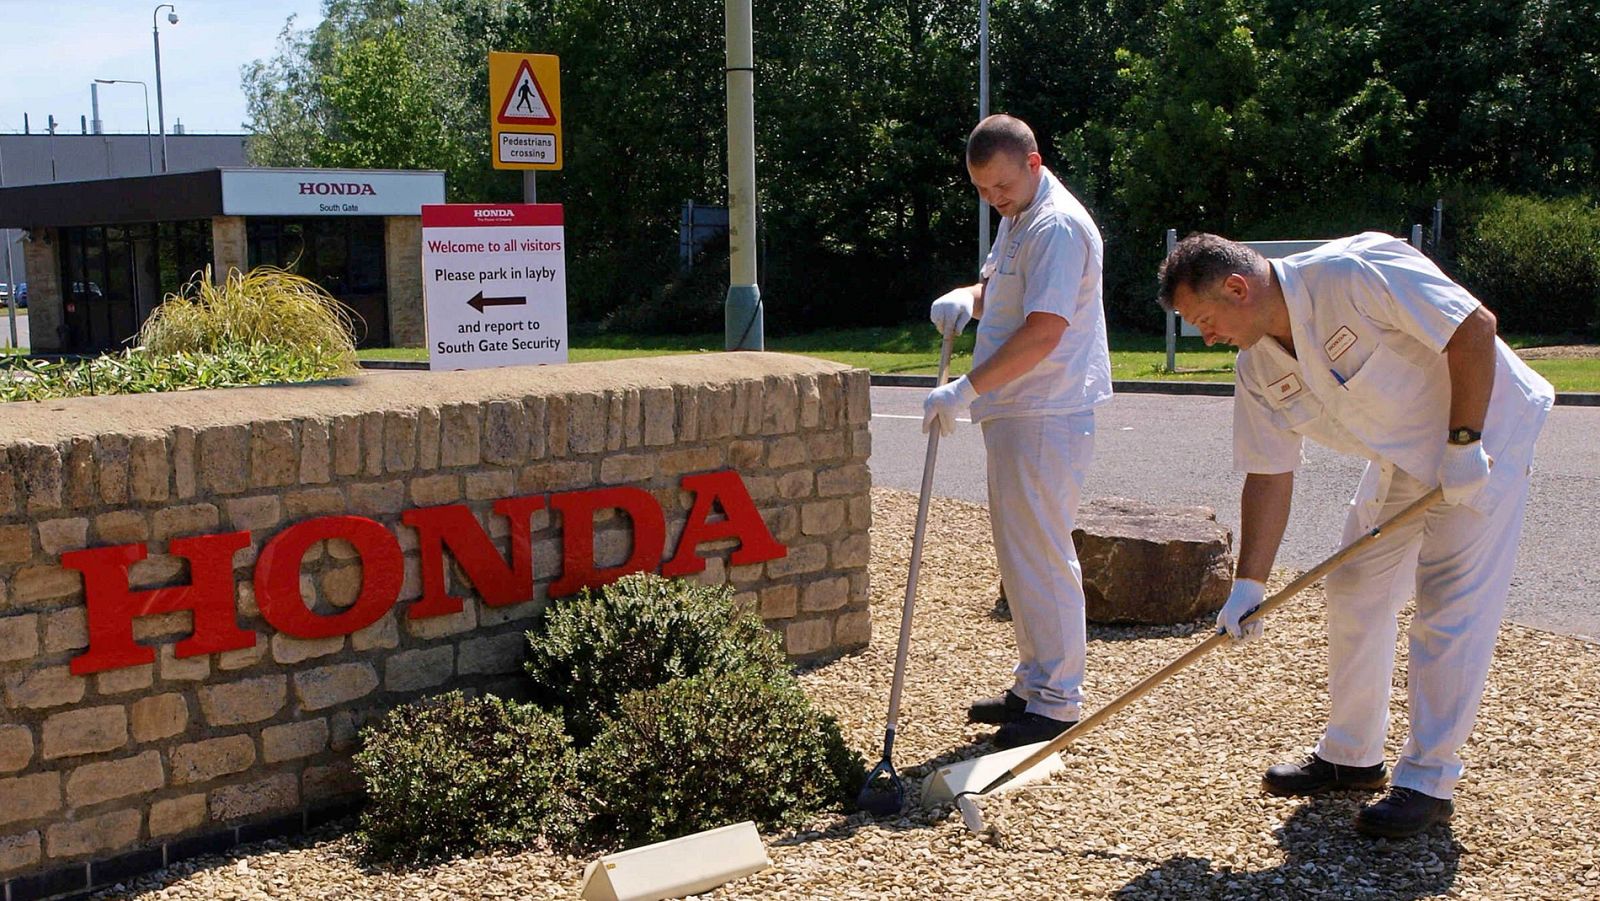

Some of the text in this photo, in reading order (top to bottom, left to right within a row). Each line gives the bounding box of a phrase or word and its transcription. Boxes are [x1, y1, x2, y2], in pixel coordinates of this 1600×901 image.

[503, 136, 552, 147] Pedestrians
[510, 149, 546, 159] crossing
[298, 182, 377, 196] HONDA
[319, 203, 359, 212] South Gate
[473, 209, 515, 218] HONDA
[428, 239, 561, 253] Welcome to all visitors
[435, 266, 556, 284] Please park in layby
[458, 320, 540, 335] and report to
[437, 336, 561, 354] South Gate Security
[61, 470, 788, 676] HONDA
